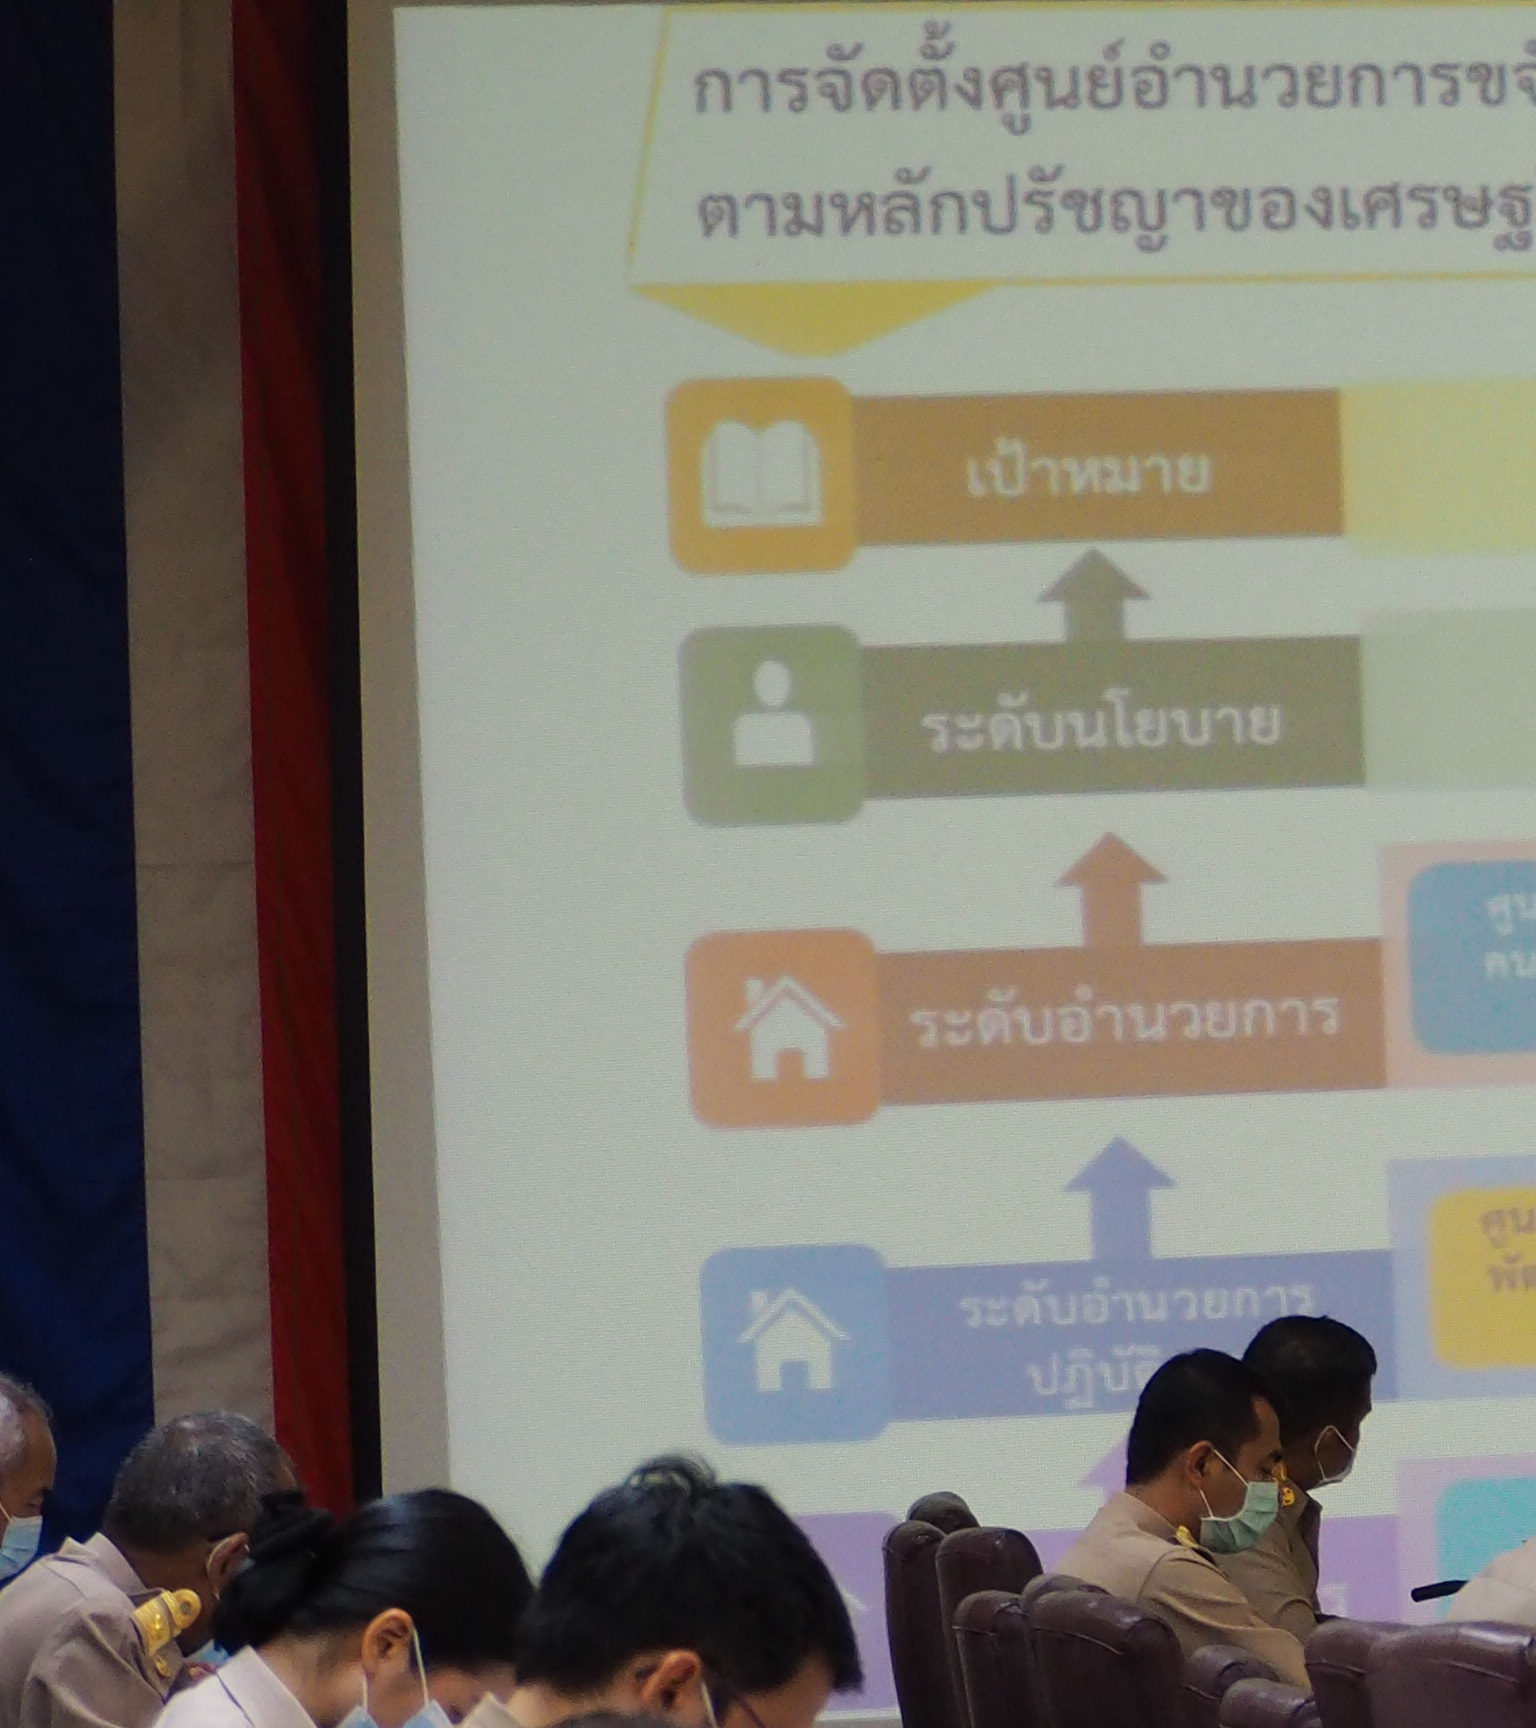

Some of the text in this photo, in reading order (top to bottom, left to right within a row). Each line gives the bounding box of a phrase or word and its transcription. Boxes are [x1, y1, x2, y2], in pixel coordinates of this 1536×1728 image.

[966, 437, 1211, 498] เป้าหมาย
[921, 688, 1281, 753] ระดับนโยบาย
[909, 984, 1339, 1049] ระดับอำนวยการ
